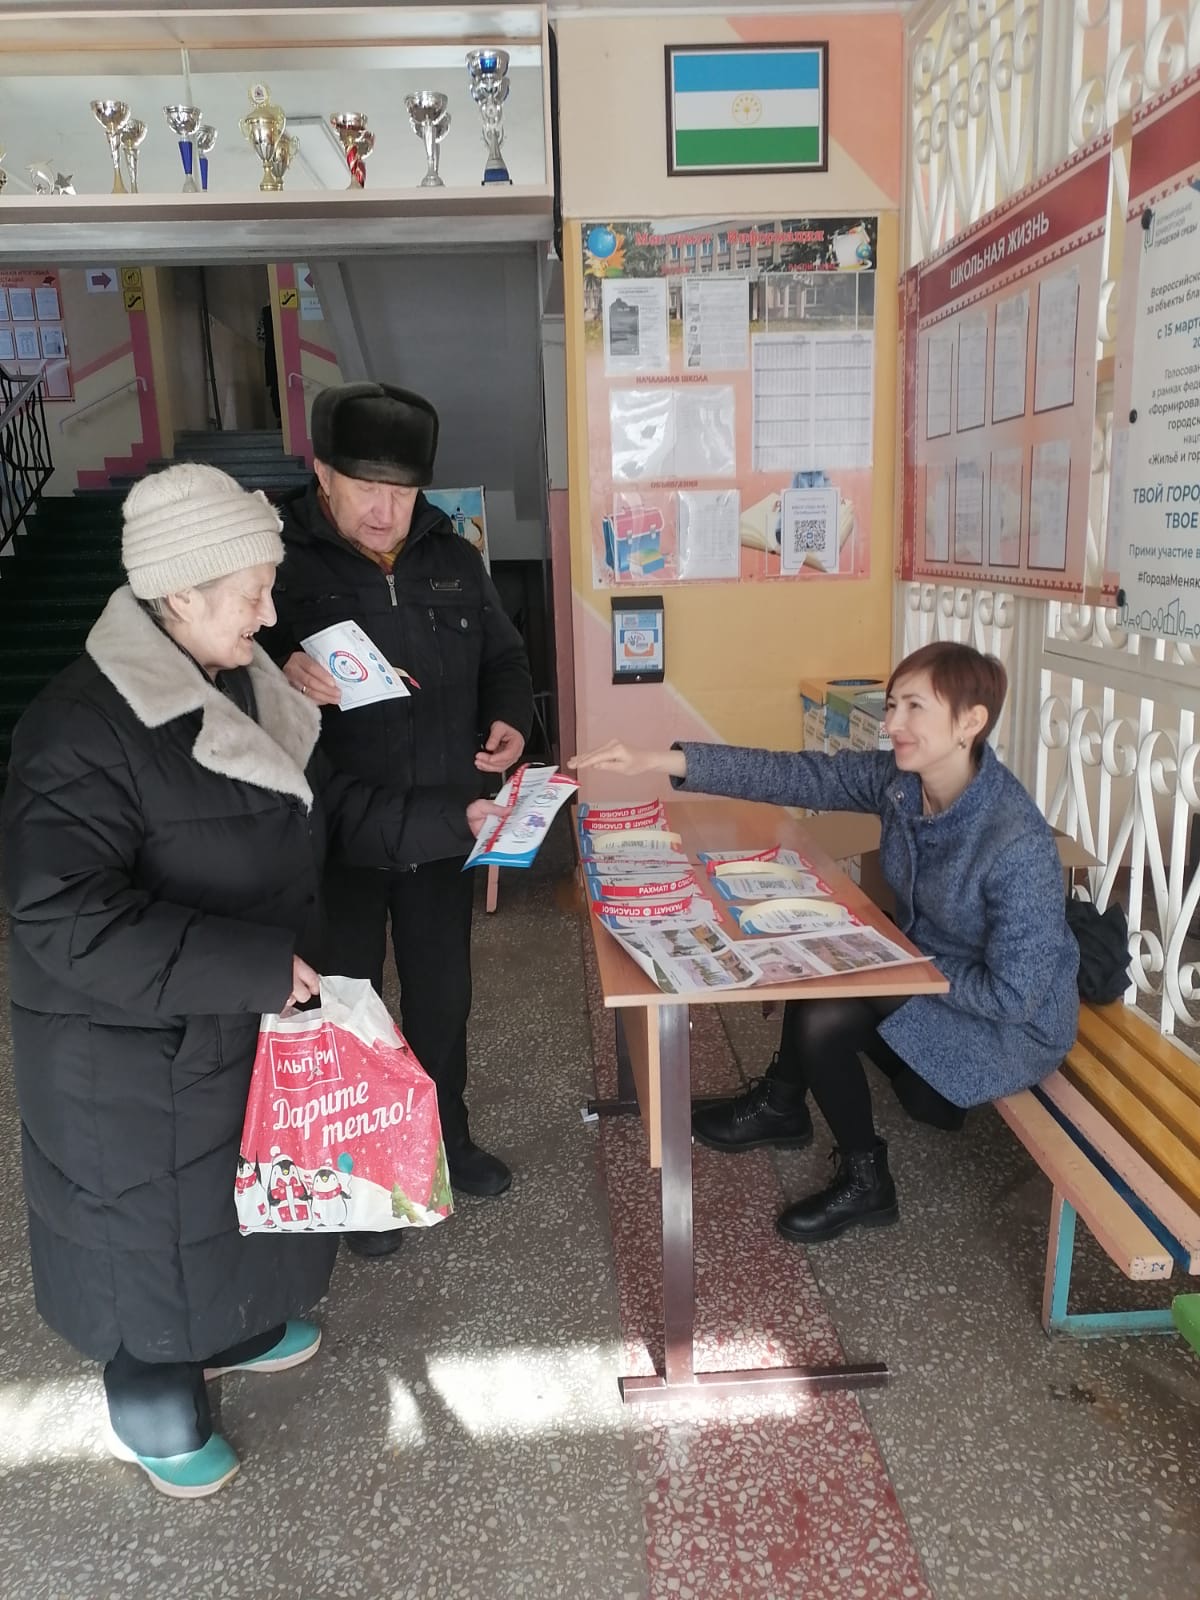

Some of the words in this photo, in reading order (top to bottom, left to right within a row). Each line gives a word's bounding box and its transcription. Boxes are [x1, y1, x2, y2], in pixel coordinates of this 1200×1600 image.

[950, 236, 1005, 290] ШКОЛЬНАЯ
[1007, 210, 1050, 256] ЖИЗНЬ
[1155, 293, 1185, 312] объекты
[1157, 328, 1163, 340] с
[1165, 322, 1173, 337] 15
[1157, 383, 1182, 400] рамках
[1148, 451, 1179, 465] «Жильё
[1180, 452, 1186, 463] и
[1133, 483, 1164, 504] ТВОЙ
[1166, 484, 1200, 503] ГОРО
[1165, 512, 1199, 529] ТВОЕ
[1129, 543, 1157, 559] Прими
[1157, 546, 1194, 560] участие
[639, 884, 669, 894] РАХМАТ!
[602, 905, 641, 915] СПАСИБО!
[272, 1081, 369, 1140] Дарите
[322, 1088, 415, 1148] тепло!
